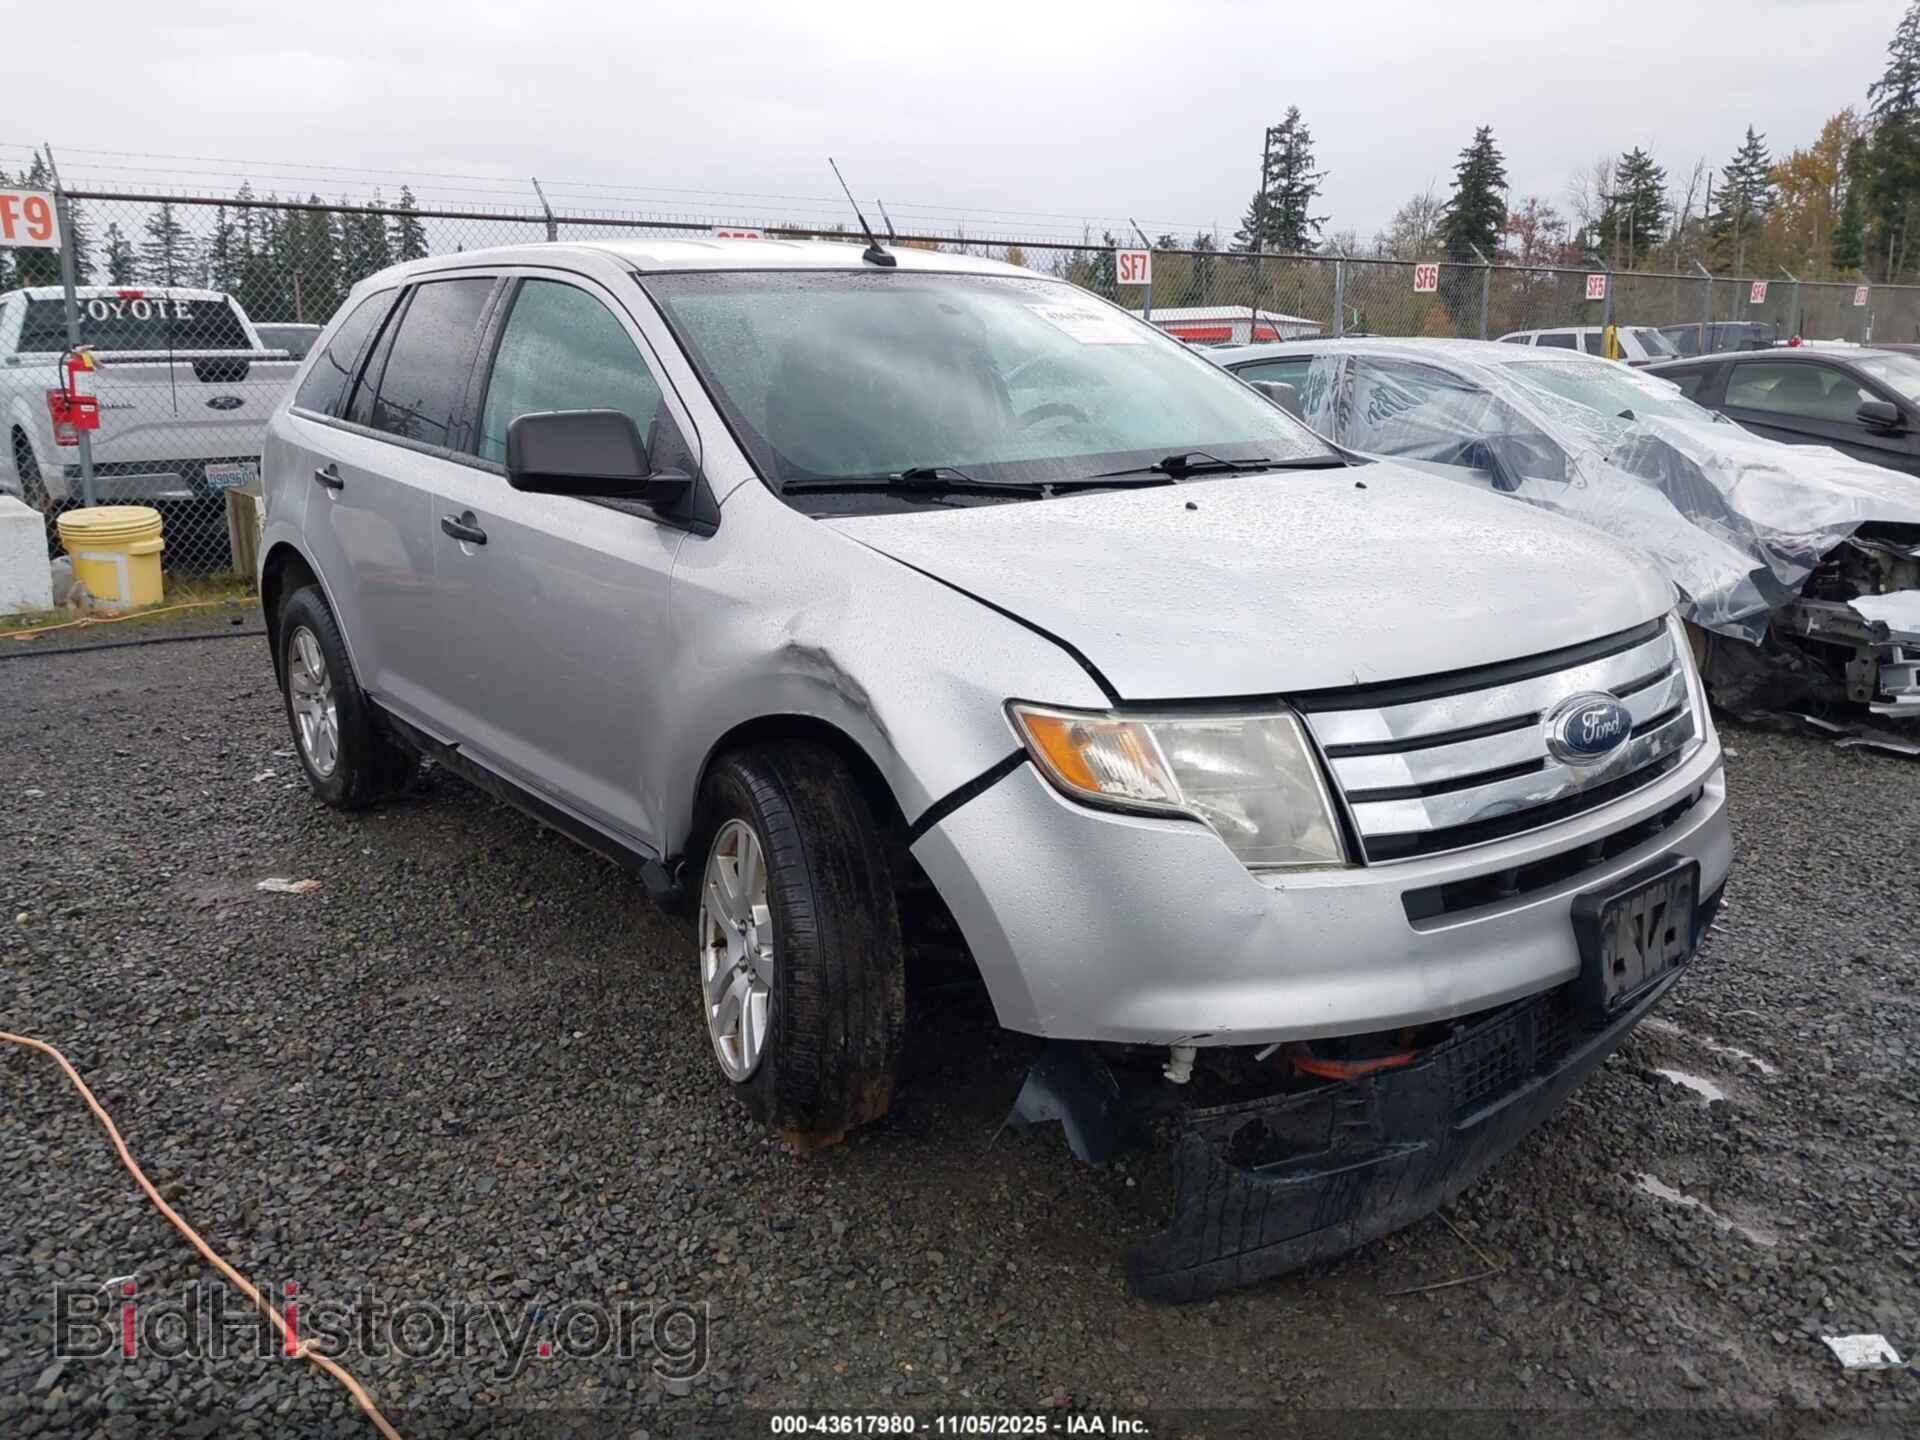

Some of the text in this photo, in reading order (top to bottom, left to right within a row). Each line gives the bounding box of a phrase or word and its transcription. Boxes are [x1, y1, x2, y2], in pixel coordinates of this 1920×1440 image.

[0, 195, 52, 240] F9
[1120, 254, 1147, 280] SF7
[1416, 266, 1436, 289] SF6
[1588, 277, 1604, 297] SF5
[1582, 708, 1621, 744] Ford
